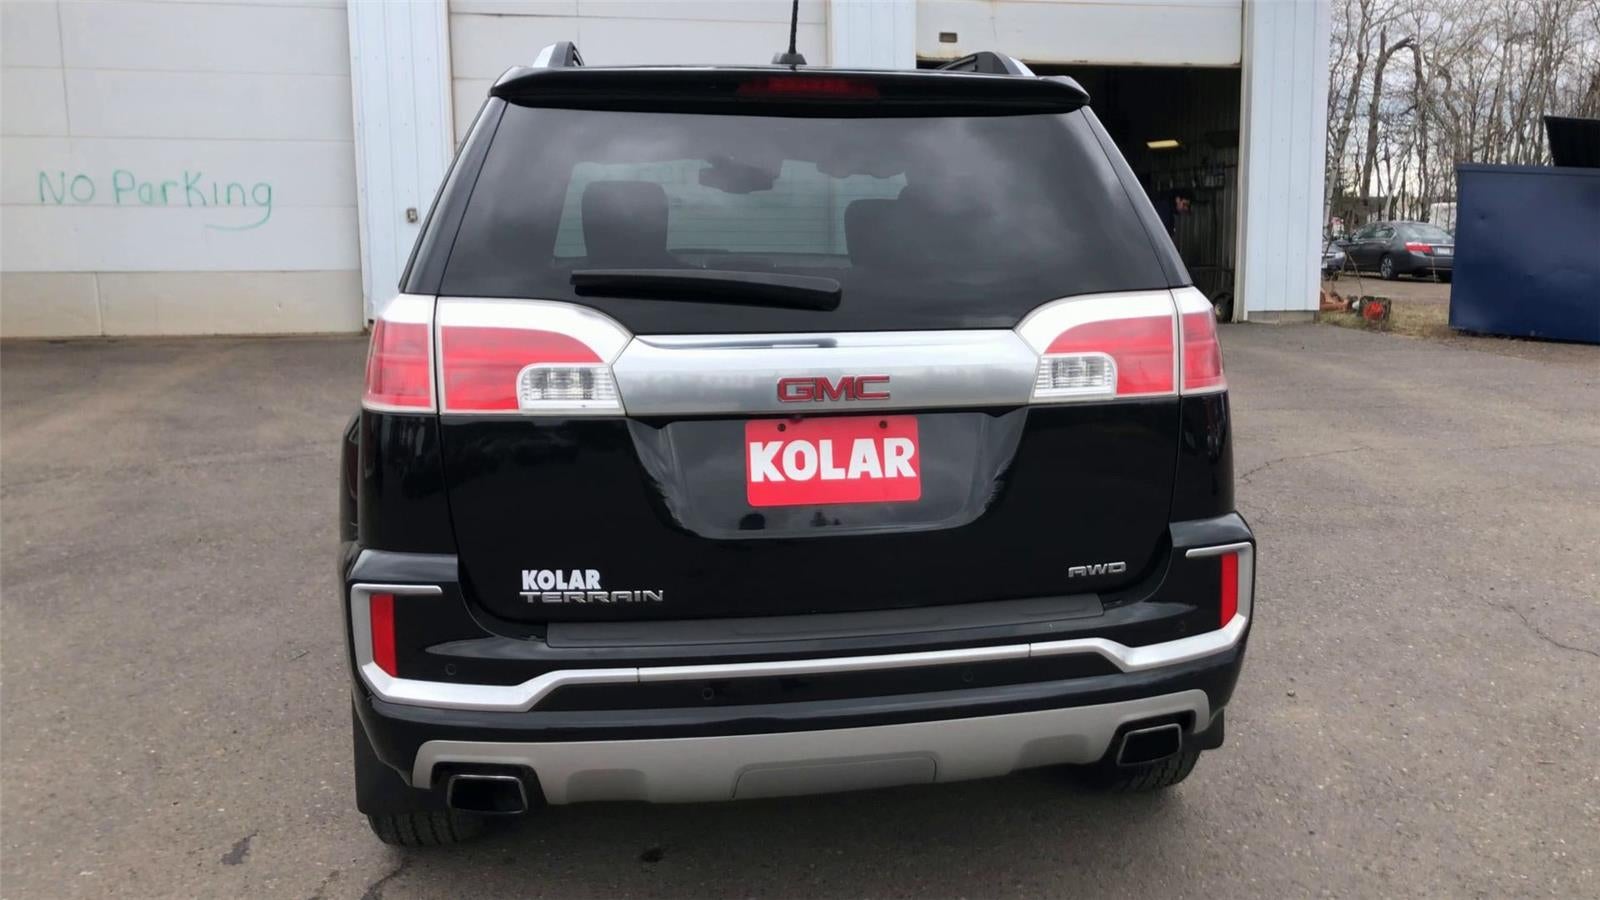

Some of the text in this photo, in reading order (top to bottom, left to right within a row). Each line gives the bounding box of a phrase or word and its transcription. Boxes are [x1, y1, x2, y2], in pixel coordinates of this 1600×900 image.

[777, 374, 890, 403] GMC
[749, 437, 916, 482] KOLAR
[521, 569, 601, 590] KOLAR
[1068, 561, 1126, 578] AWD
[519, 590, 664, 603] TERRAIN
